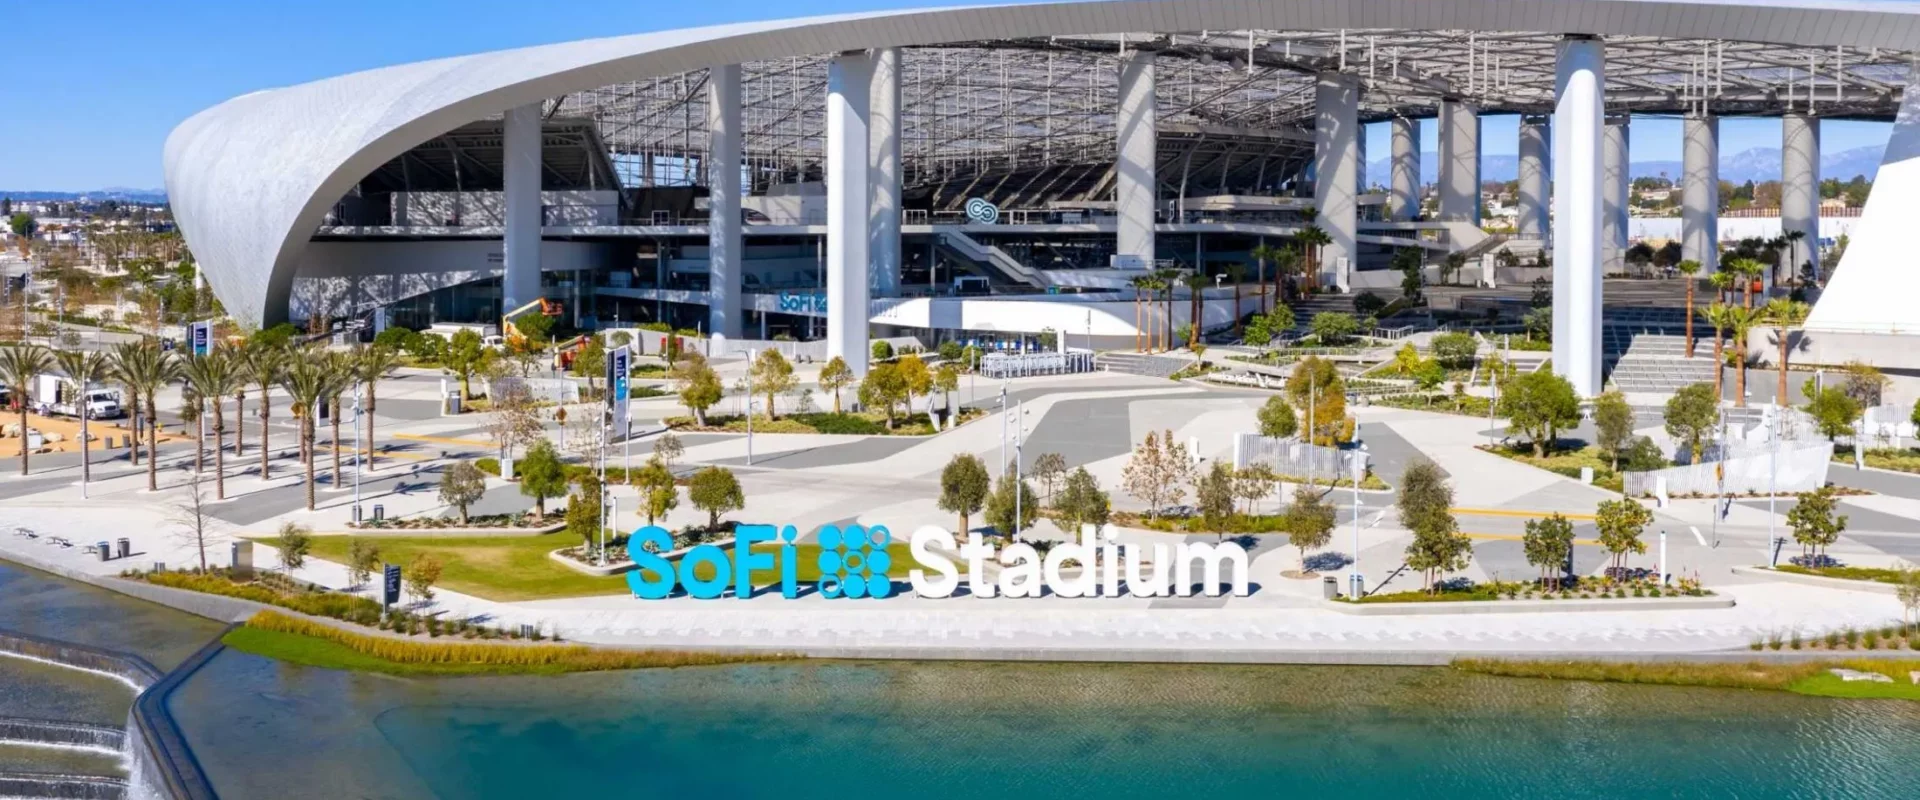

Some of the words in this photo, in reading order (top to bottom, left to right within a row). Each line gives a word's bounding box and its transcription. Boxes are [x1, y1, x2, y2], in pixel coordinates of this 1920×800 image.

[780, 291, 811, 312] SoFi
[626, 524, 797, 599] SoFi
[909, 524, 1249, 598] Stadium
